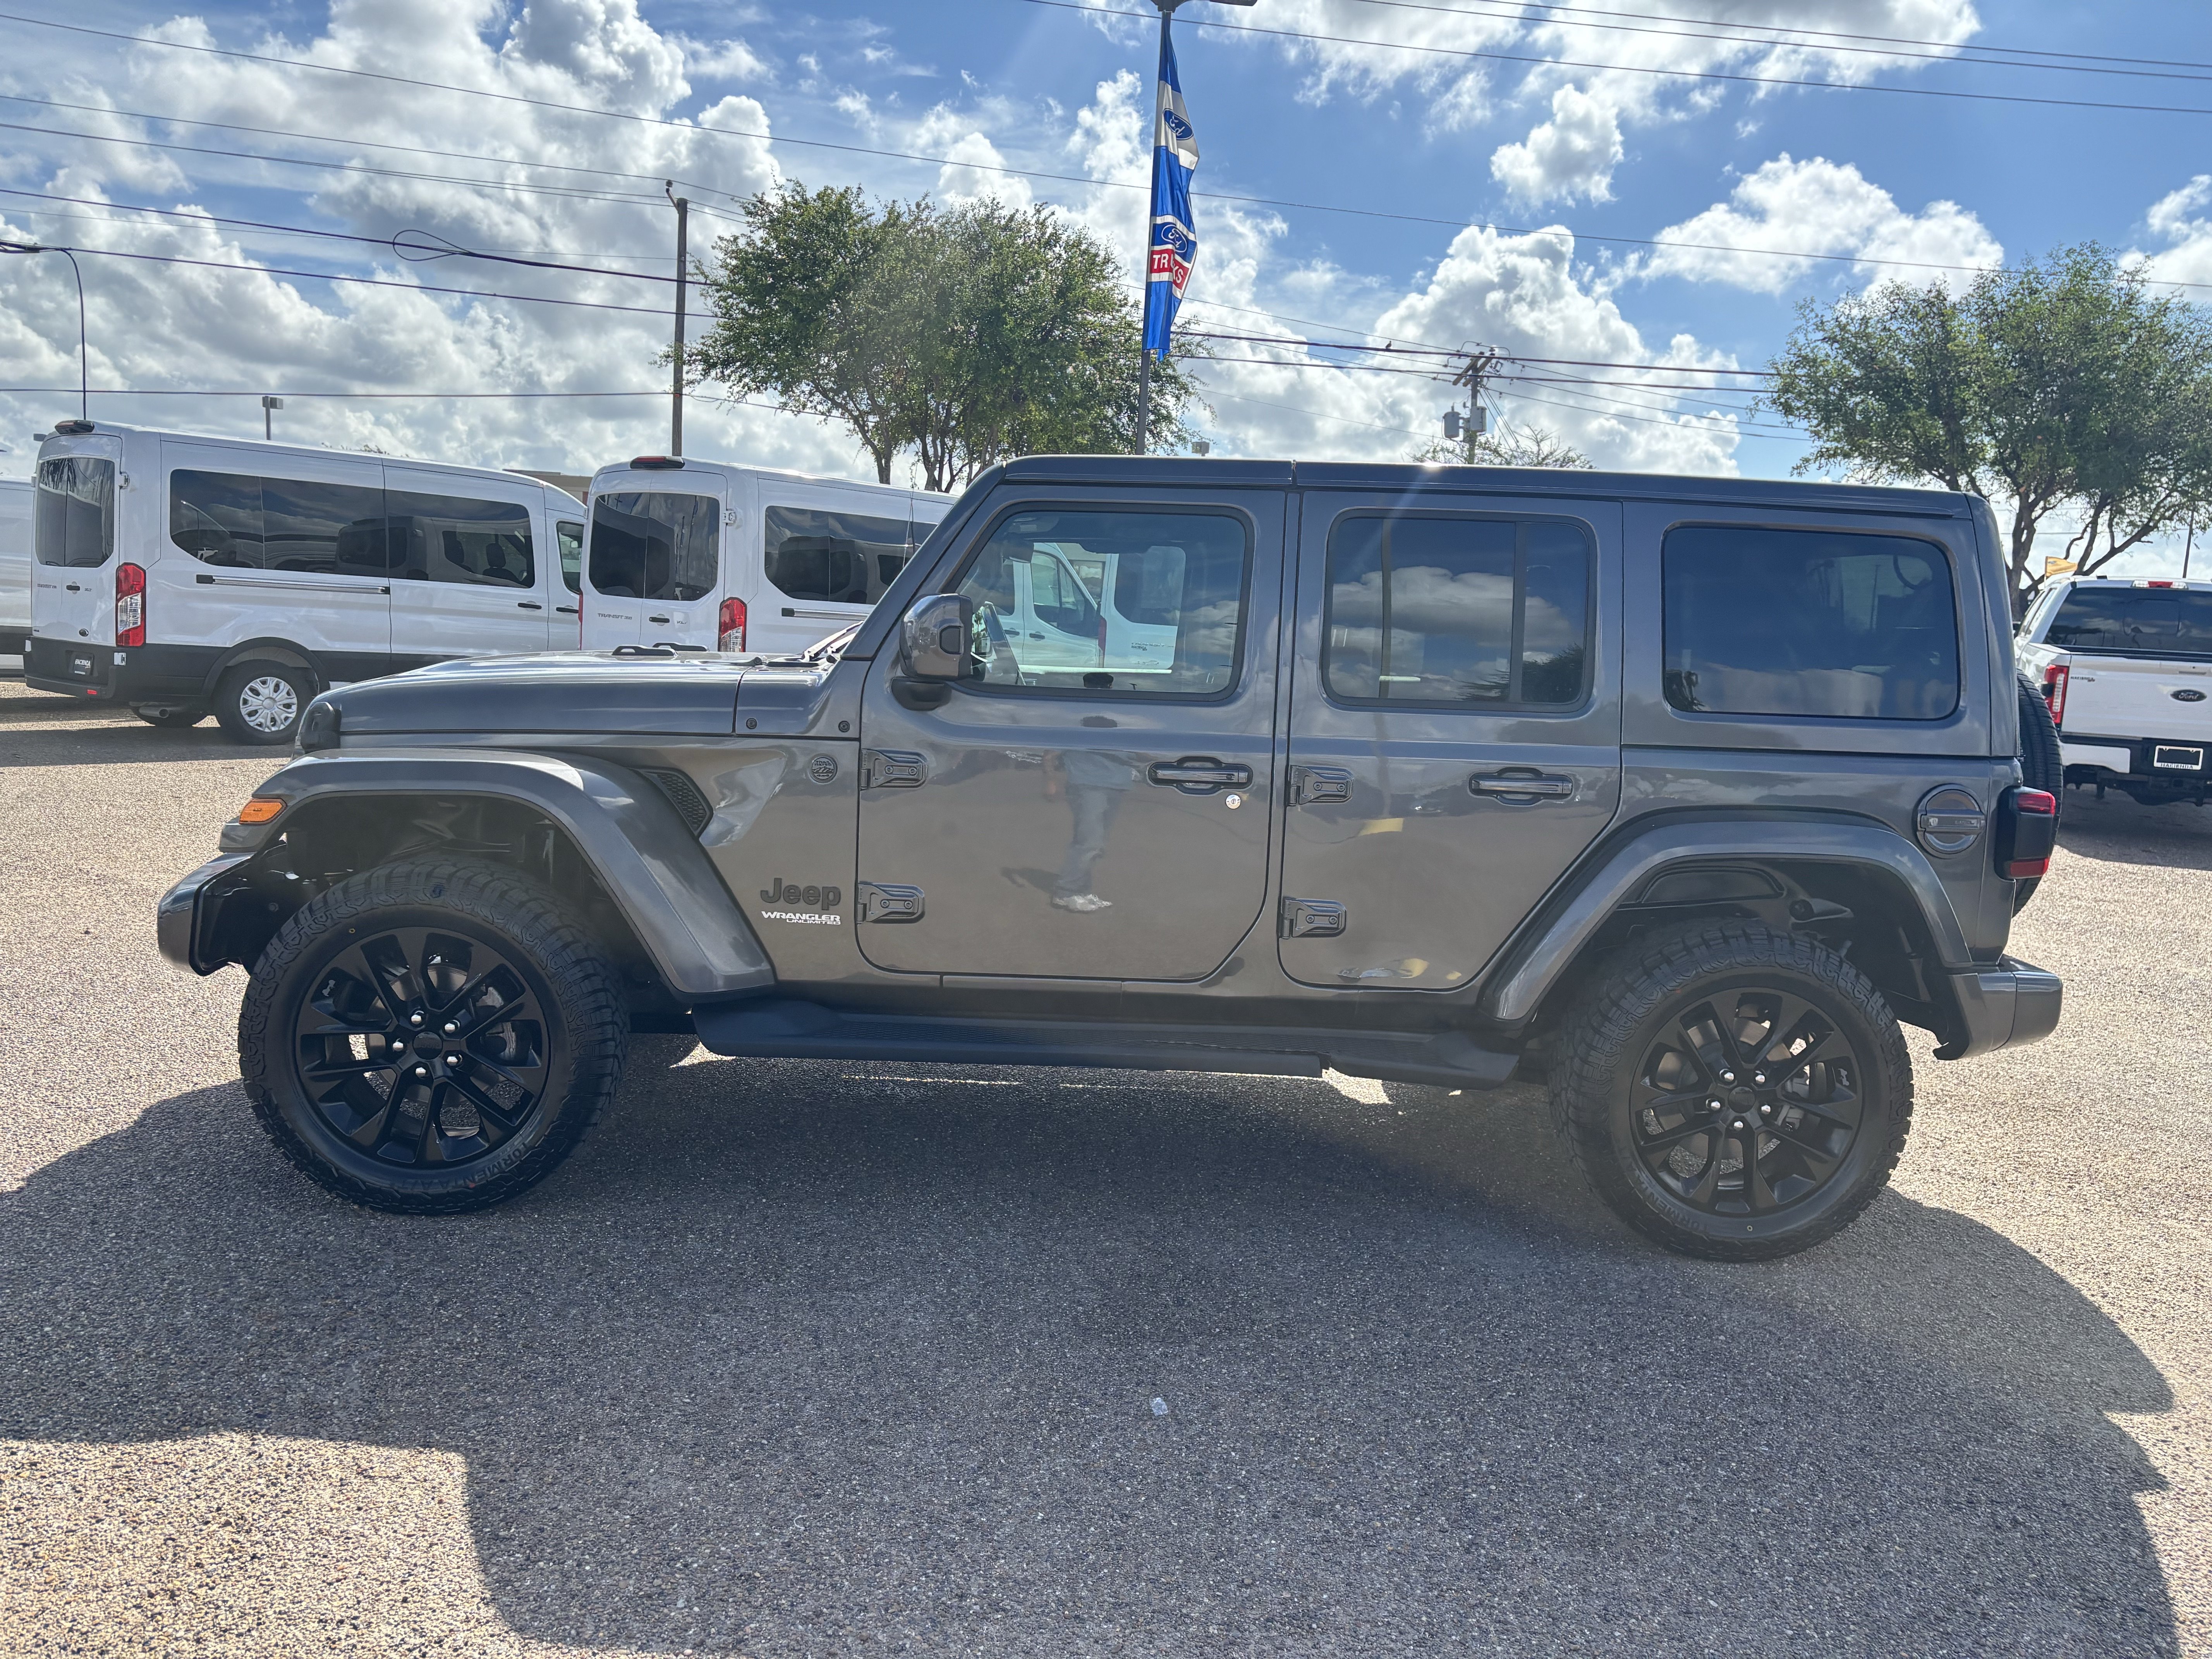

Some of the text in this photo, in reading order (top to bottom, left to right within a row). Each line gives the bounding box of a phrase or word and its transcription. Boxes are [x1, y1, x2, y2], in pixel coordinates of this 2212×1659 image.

[1153, 253, 1183, 283] TRUKS
[760, 878, 841, 910] Jeep
[761, 911, 841, 921] WRANGLER
